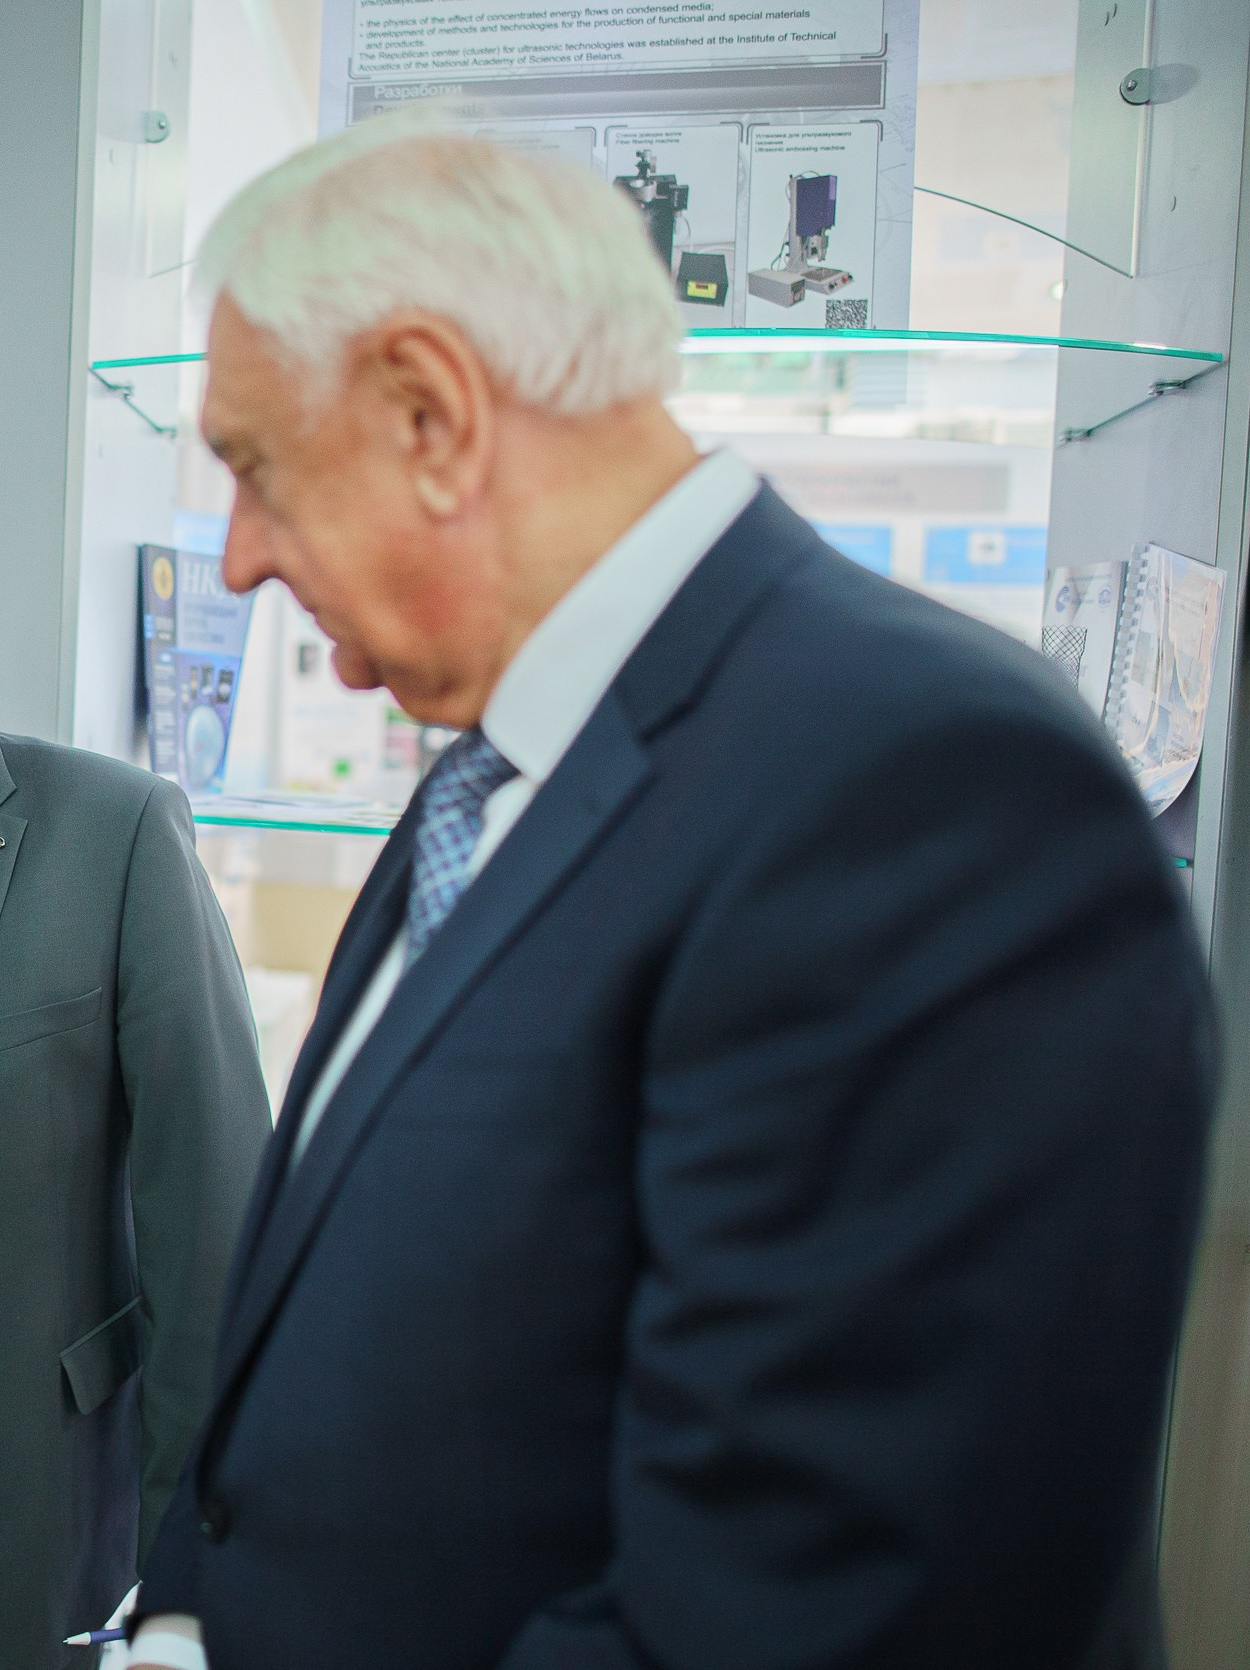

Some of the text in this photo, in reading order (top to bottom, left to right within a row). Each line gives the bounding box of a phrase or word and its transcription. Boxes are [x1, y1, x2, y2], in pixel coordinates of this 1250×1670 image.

[366, 9, 811, 38] development of methods and technologies for the production of functional and special materials
[383, 18, 417, 28] physics
[419, 16, 429, 25] of
[431, 15, 445, 24] the
[448, 14, 473, 23] effect
[475, 13, 485, 22] of
[487, 10, 547, 21] concentrated
[550, 8, 582, 18] energy
[584, 7, 609, 16] flows
[626, 4, 679, 14] condensed
[681, 3, 714, 12] media;
[359, 31, 837, 60] The Republican center (cluster) for ultrasonic technologies was established at the Institute of Technical
[365, 42, 383, 50] and
[359, 63, 400, 71] Acoustics
[403, 62, 412, 70] of
[414, 61, 429, 69] the
[432, 59, 469, 68] National
[471, 57, 515, 67] Academy
[517, 56, 527, 64] of
[529, 54, 571, 63] Sciences
[573, 53, 584, 62] of
[374, 83, 462, 99] Разработки
